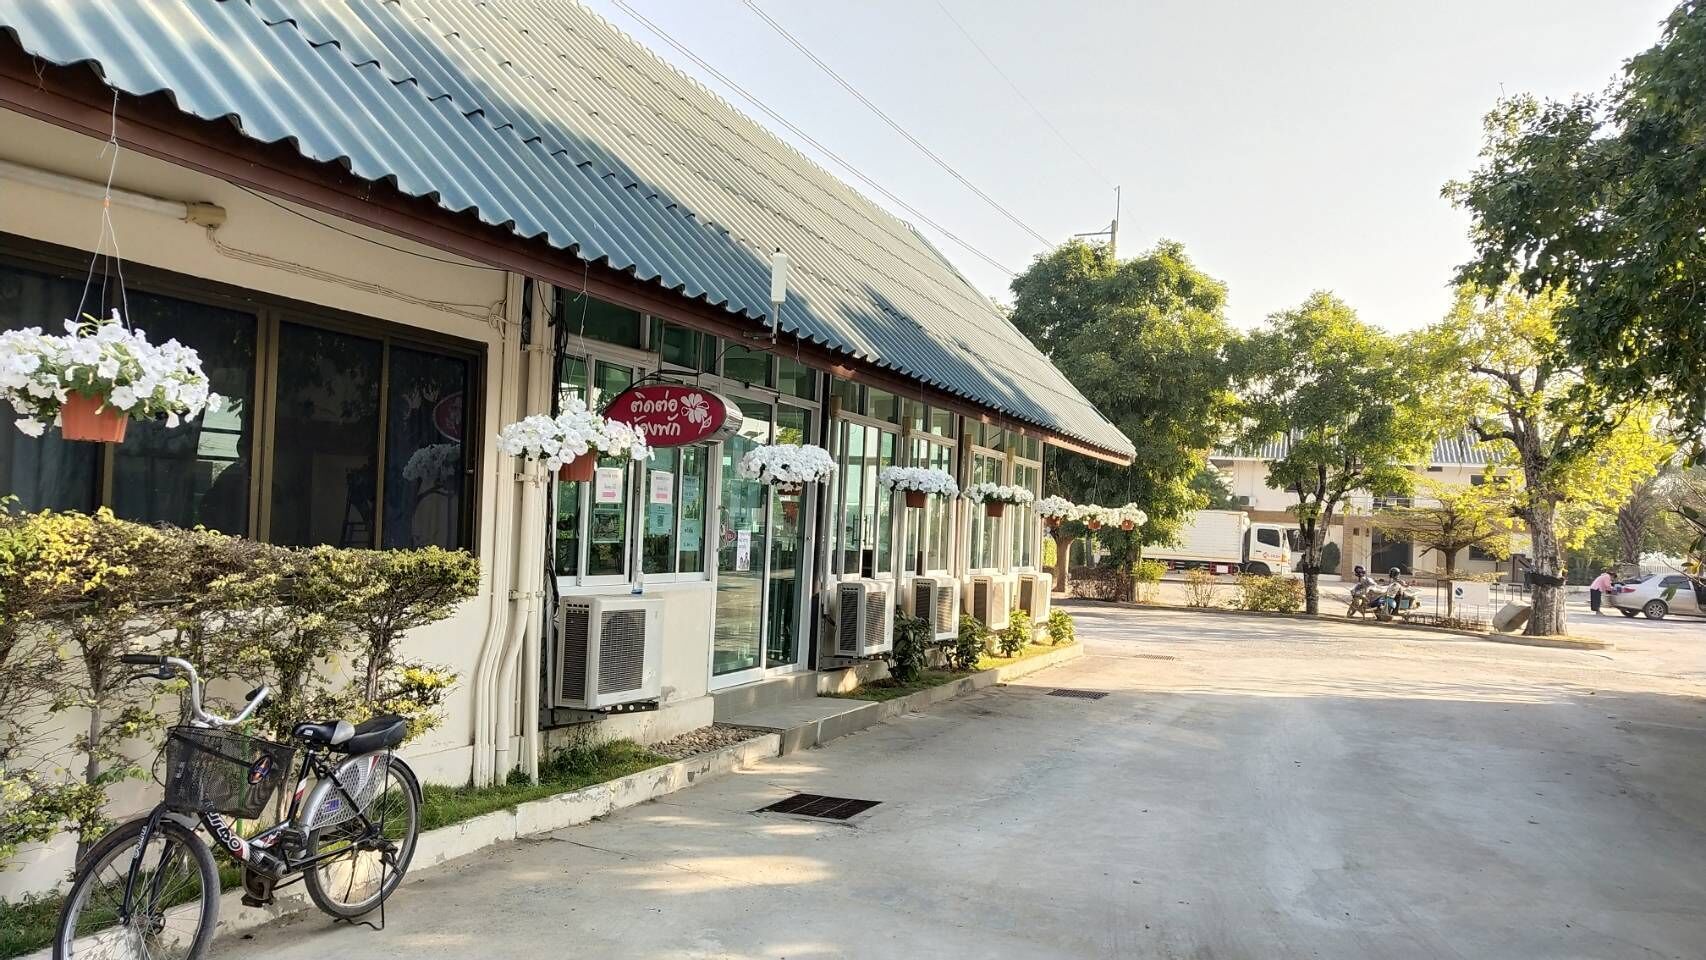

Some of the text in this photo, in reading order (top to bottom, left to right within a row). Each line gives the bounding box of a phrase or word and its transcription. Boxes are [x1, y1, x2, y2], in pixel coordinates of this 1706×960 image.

[630, 389, 678, 413] ติดต่อ
[633, 413, 681, 436] ้องพัก
